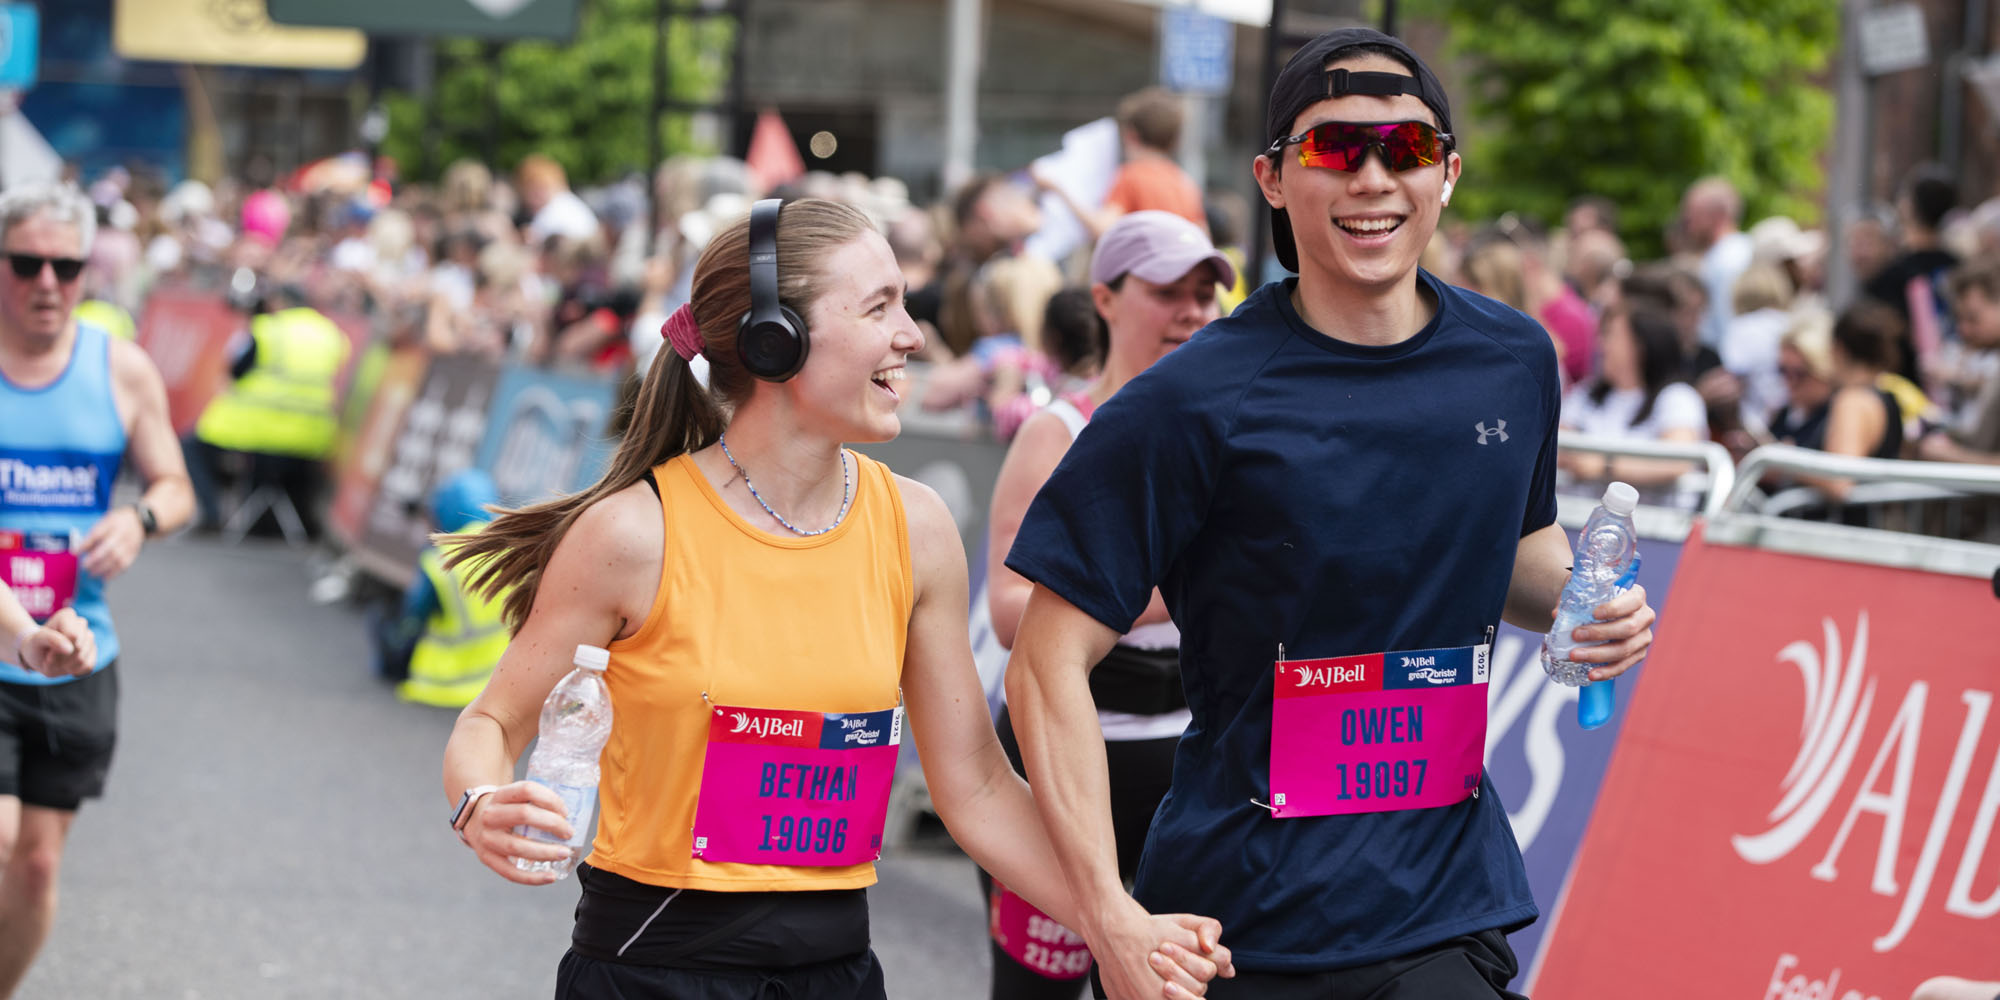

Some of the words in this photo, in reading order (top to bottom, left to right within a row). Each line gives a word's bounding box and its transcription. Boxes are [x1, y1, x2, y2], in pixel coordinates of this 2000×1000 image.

[1409, 656, 1436, 668] AJBell
[1477, 652, 1485, 676] 2025
[1311, 664, 1366, 688] AJBell
[1408, 670, 1428, 682] great
[1433, 668, 1457, 678] bristol
[746, 716, 804, 738] AJBell
[1341, 705, 1424, 746] OWEN
[759, 762, 859, 802] BETHAN
[1336, 759, 1428, 801] 19097
[758, 815, 849, 854] 19096
